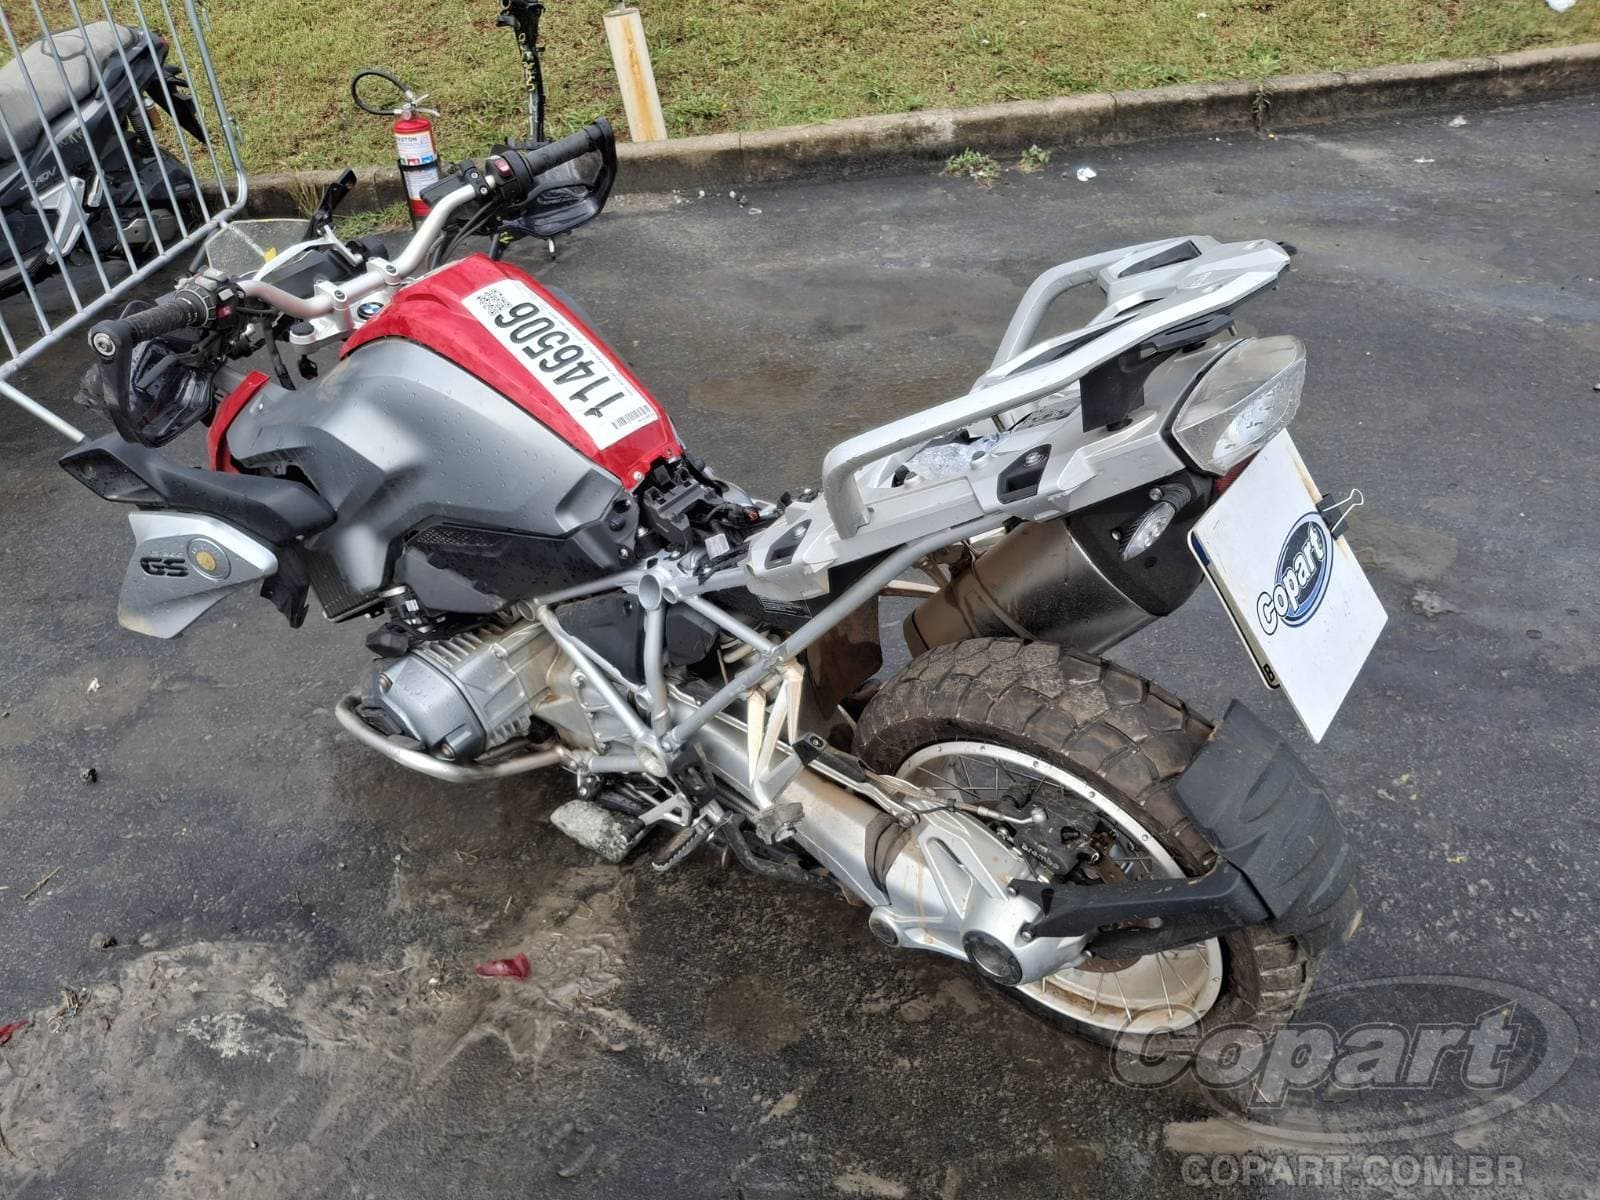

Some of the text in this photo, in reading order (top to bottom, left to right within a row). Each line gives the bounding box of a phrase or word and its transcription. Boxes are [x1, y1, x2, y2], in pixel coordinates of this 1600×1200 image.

[494, 301, 625, 418] 1146506
[140, 557, 189, 577] GS
[1257, 521, 1325, 636] Copart
